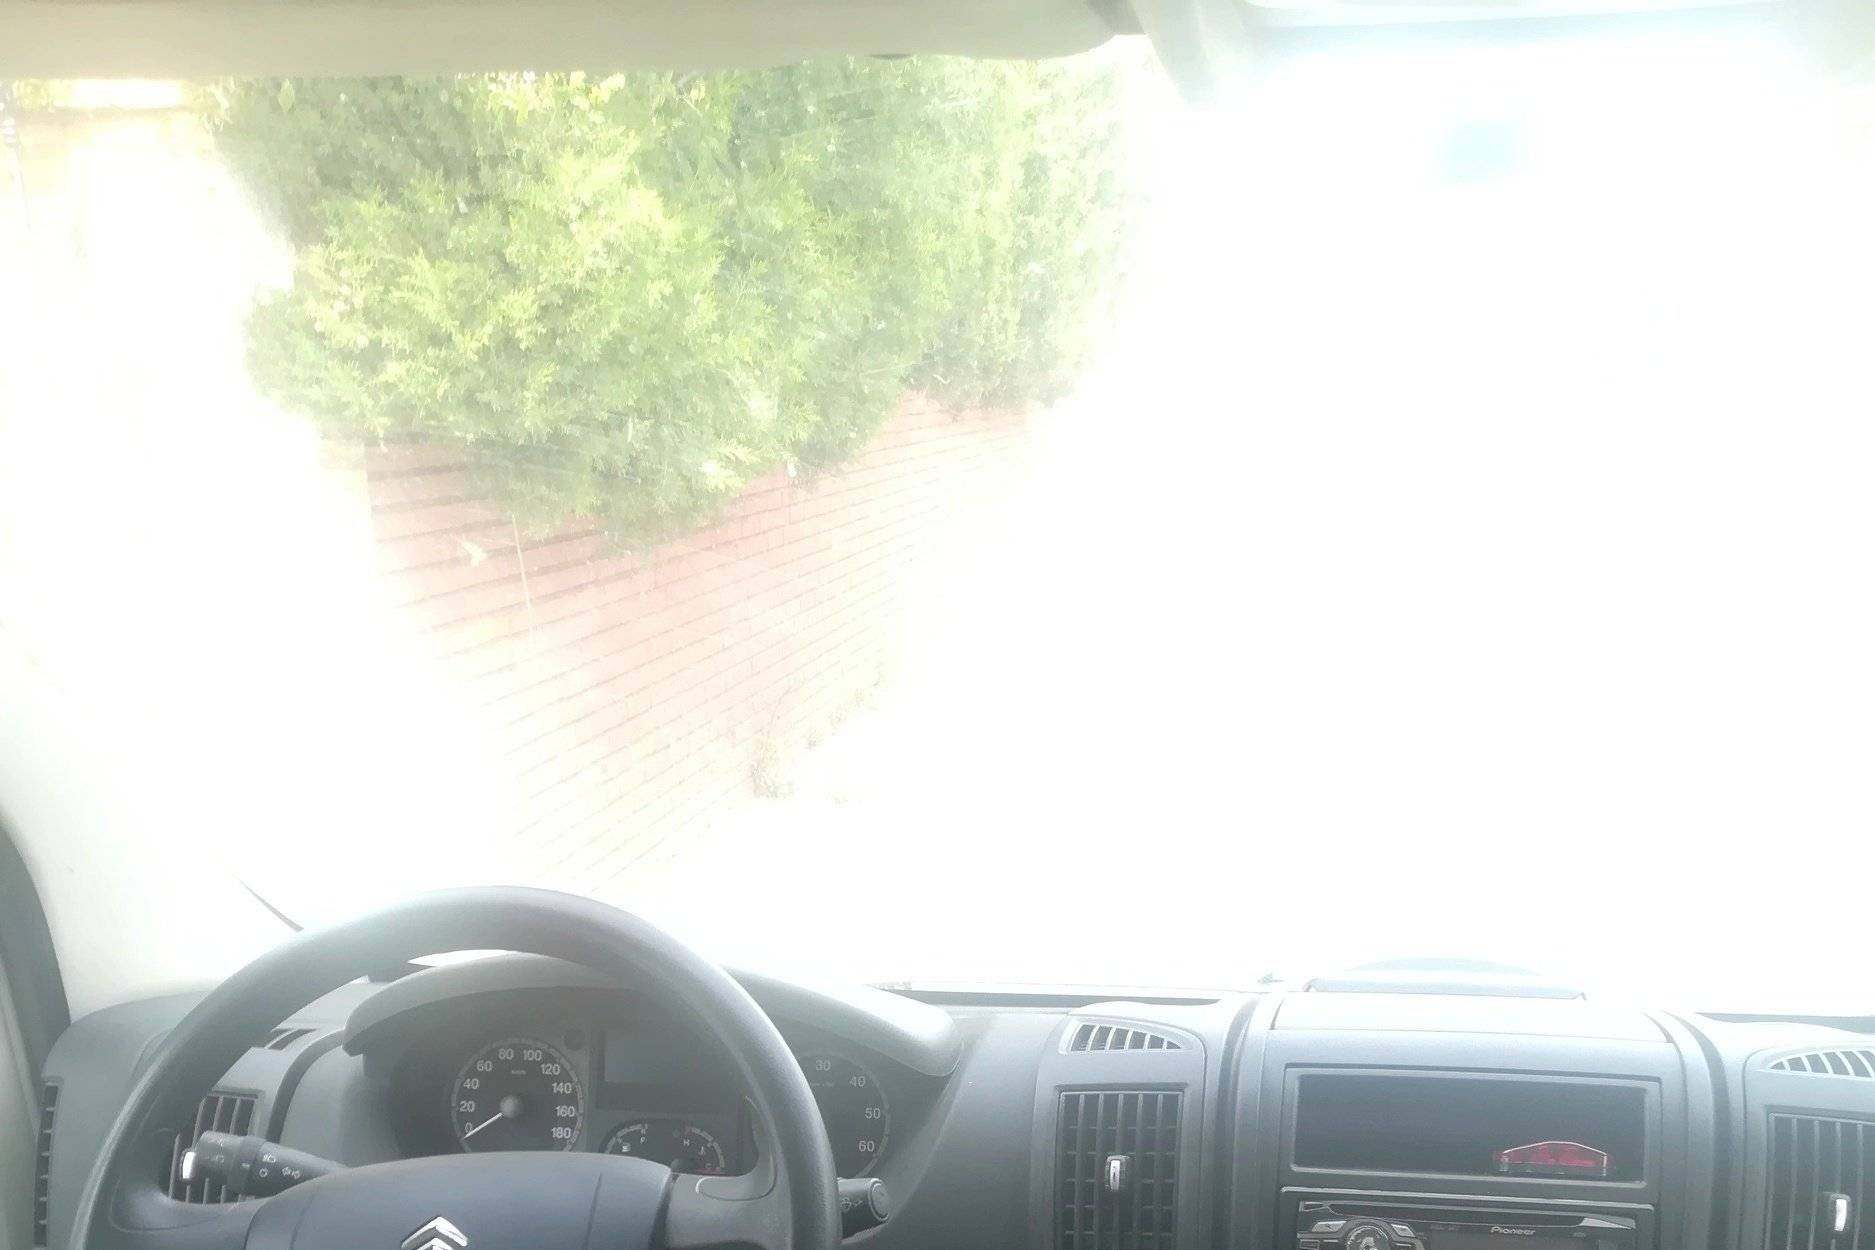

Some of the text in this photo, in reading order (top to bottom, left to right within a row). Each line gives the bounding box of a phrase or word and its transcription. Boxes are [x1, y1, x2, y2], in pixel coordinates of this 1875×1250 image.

[498, 1047, 515, 1060] 80
[522, 1048, 543, 1061] 100
[476, 1060, 493, 1072] 60
[540, 1063, 561, 1076] 120
[815, 1059, 832, 1071] 30
[462, 1078, 480, 1090] 40
[849, 1075, 866, 1087] 40
[551, 1082, 573, 1094] 140
[459, 1100, 476, 1113] 20
[555, 1105, 577, 1118] 160
[865, 1107, 881, 1119] 50
[551, 1126, 572, 1139] 180
[858, 1140, 875, 1152] 60
[1490, 1225, 1537, 1237] Pioneer
